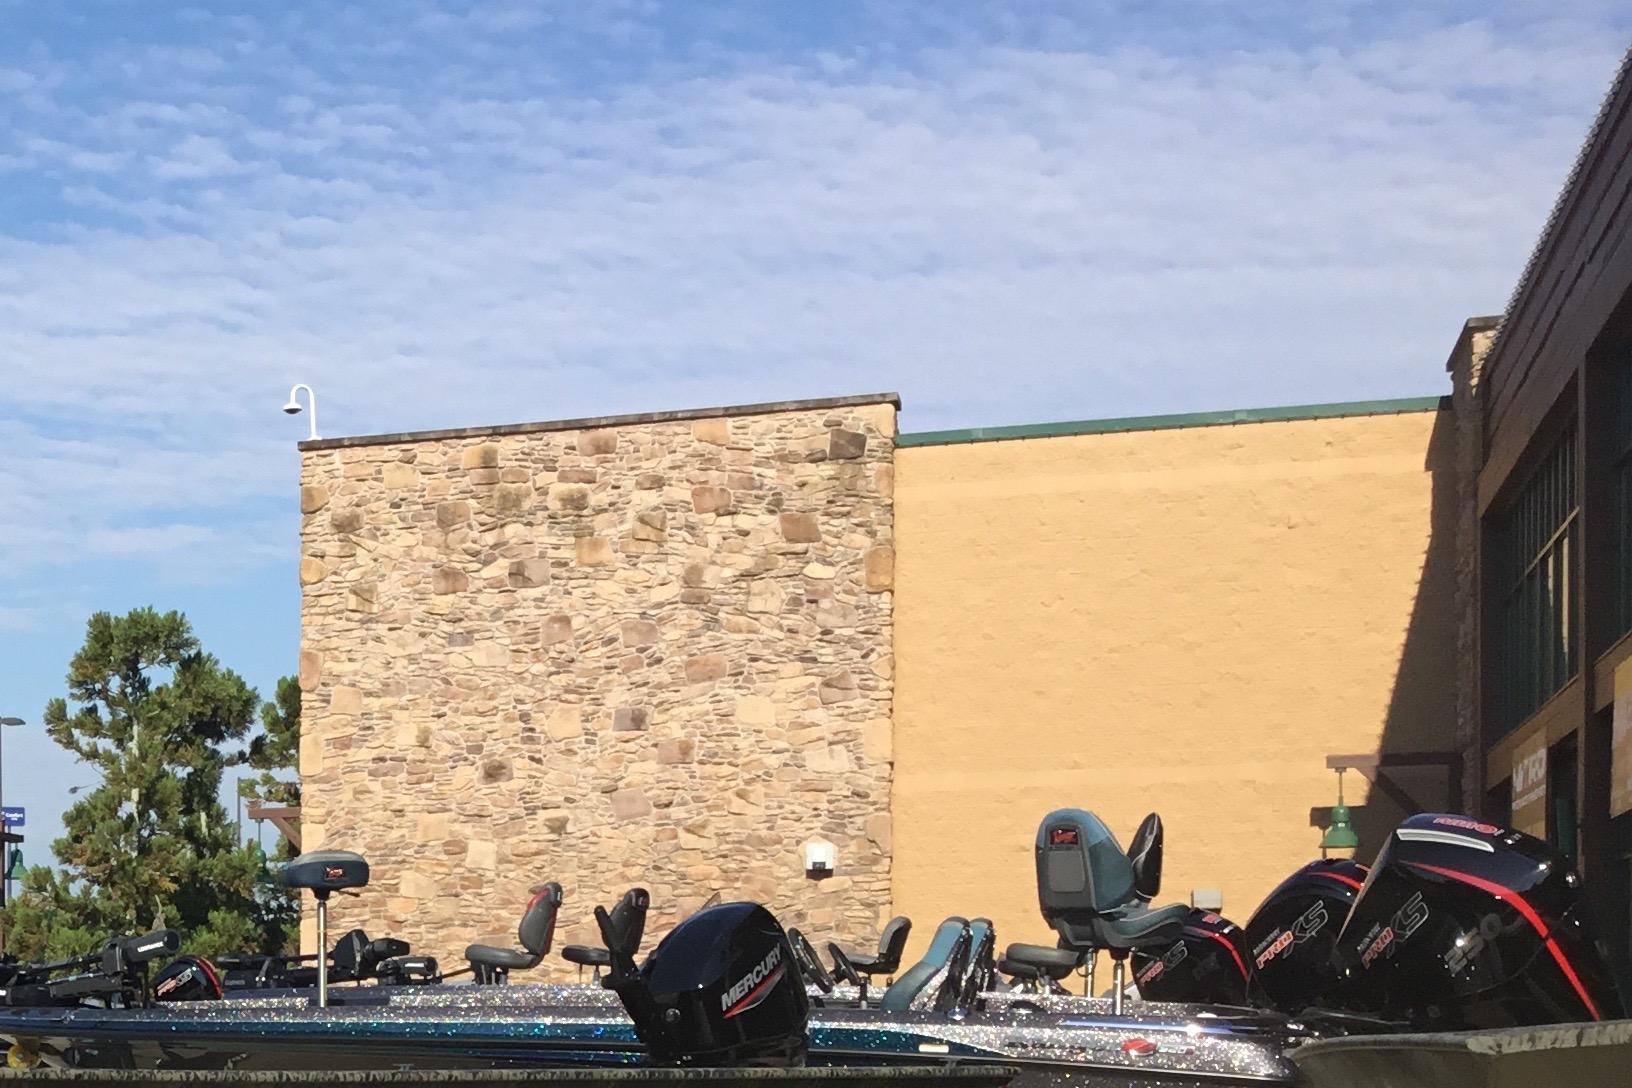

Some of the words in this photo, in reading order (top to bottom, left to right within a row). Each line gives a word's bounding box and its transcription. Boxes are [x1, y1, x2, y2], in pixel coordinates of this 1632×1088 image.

[1256, 930, 1294, 970] PRO
[1283, 900, 1329, 959] XS
[1386, 890, 1429, 960] XS
[721, 942, 781, 1012] MERCURY
